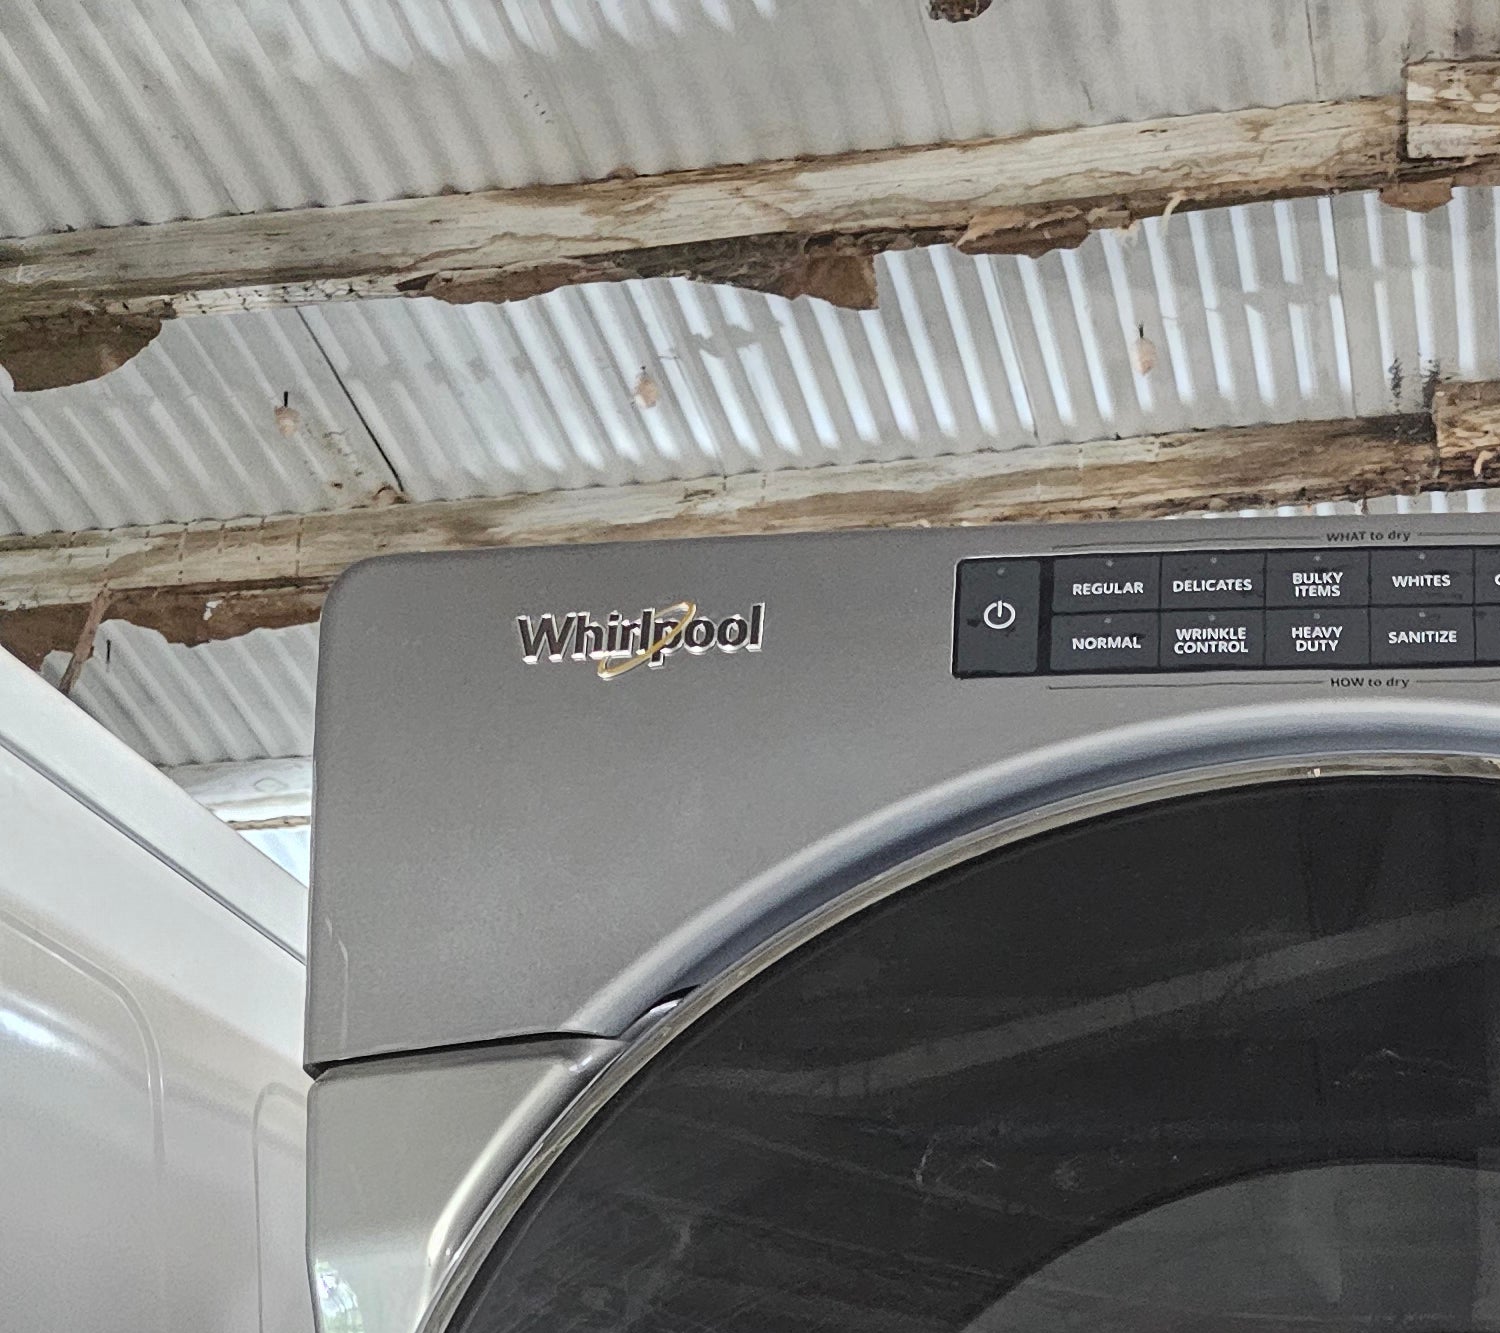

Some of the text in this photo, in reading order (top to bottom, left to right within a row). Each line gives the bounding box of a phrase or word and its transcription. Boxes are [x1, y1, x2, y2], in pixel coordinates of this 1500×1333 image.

[1326, 530, 1411, 542] WHAT to dry
[1292, 572, 1343, 585] BULKY
[1392, 574, 1451, 587] WHITES
[1072, 581, 1144, 596] REGULAR
[1173, 578, 1252, 593] DELICATES
[1294, 585, 1341, 597] ITEMS
[517, 601, 765, 669] Whirlpool
[1176, 627, 1247, 641] WRINKLE
[1292, 626, 1343, 639] HEAVY
[1388, 630, 1457, 644] SANITIZE
[1072, 636, 1141, 650] NORMAL
[1174, 640, 1248, 654] CONTROL
[1296, 639, 1339, 652] DUTY
[1330, 677, 1410, 689] HOW to dry
